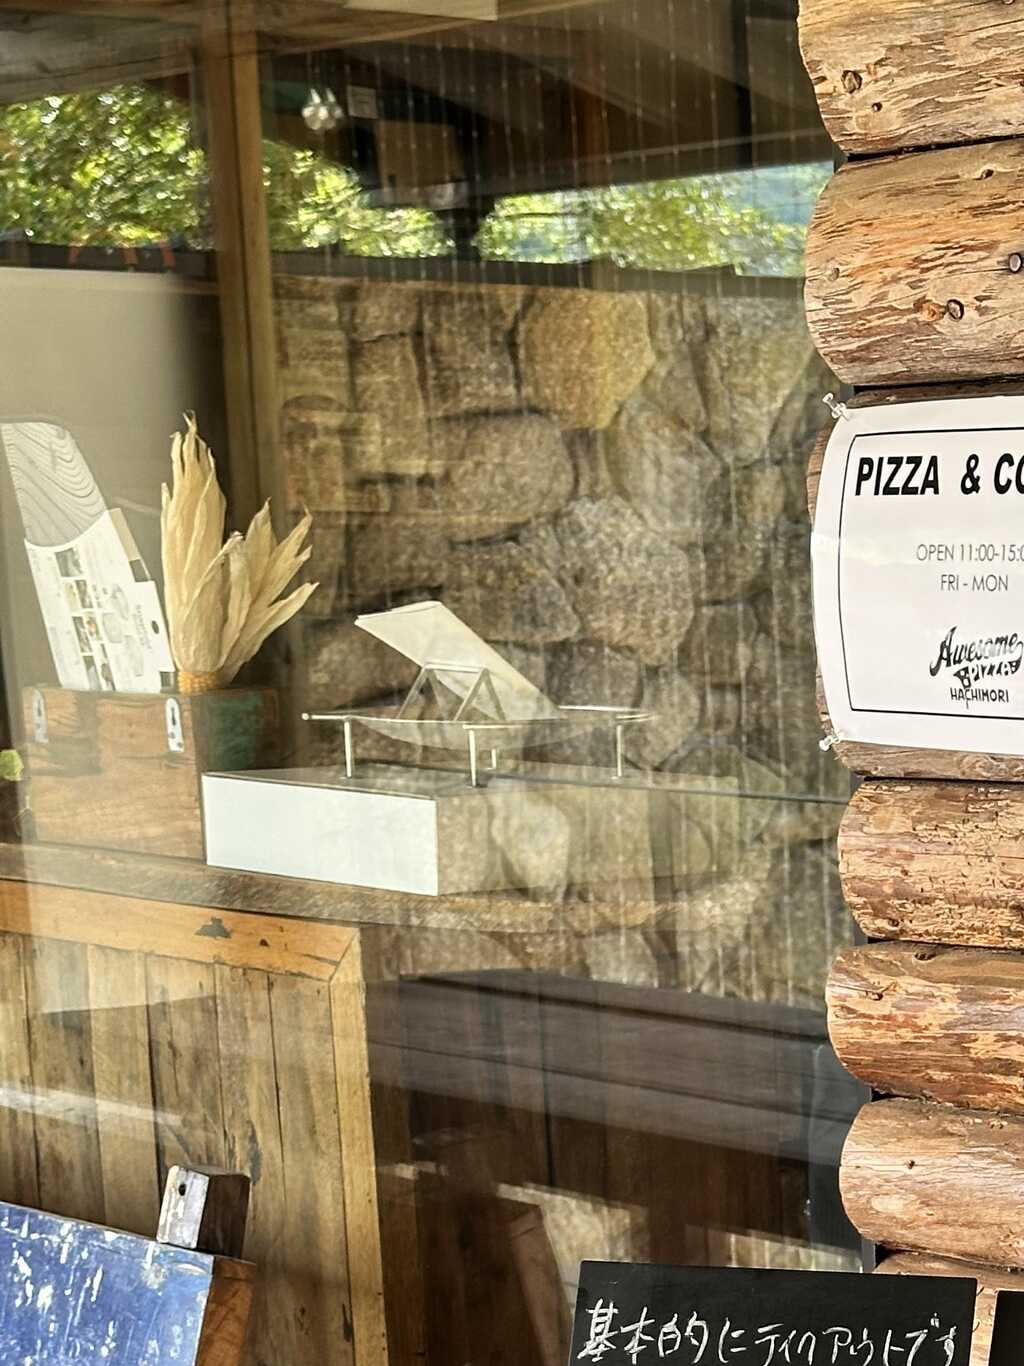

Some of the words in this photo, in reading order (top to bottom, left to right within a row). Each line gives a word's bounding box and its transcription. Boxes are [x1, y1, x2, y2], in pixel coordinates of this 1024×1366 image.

[855, 455, 940, 496] PIZZA
[960, 453, 981, 495] &
[916, 544, 954, 562] OPEN
[940, 575, 960, 592] FRI
[972, 575, 1009, 592] MON
[950, 687, 1009, 703] HACHIMORI
